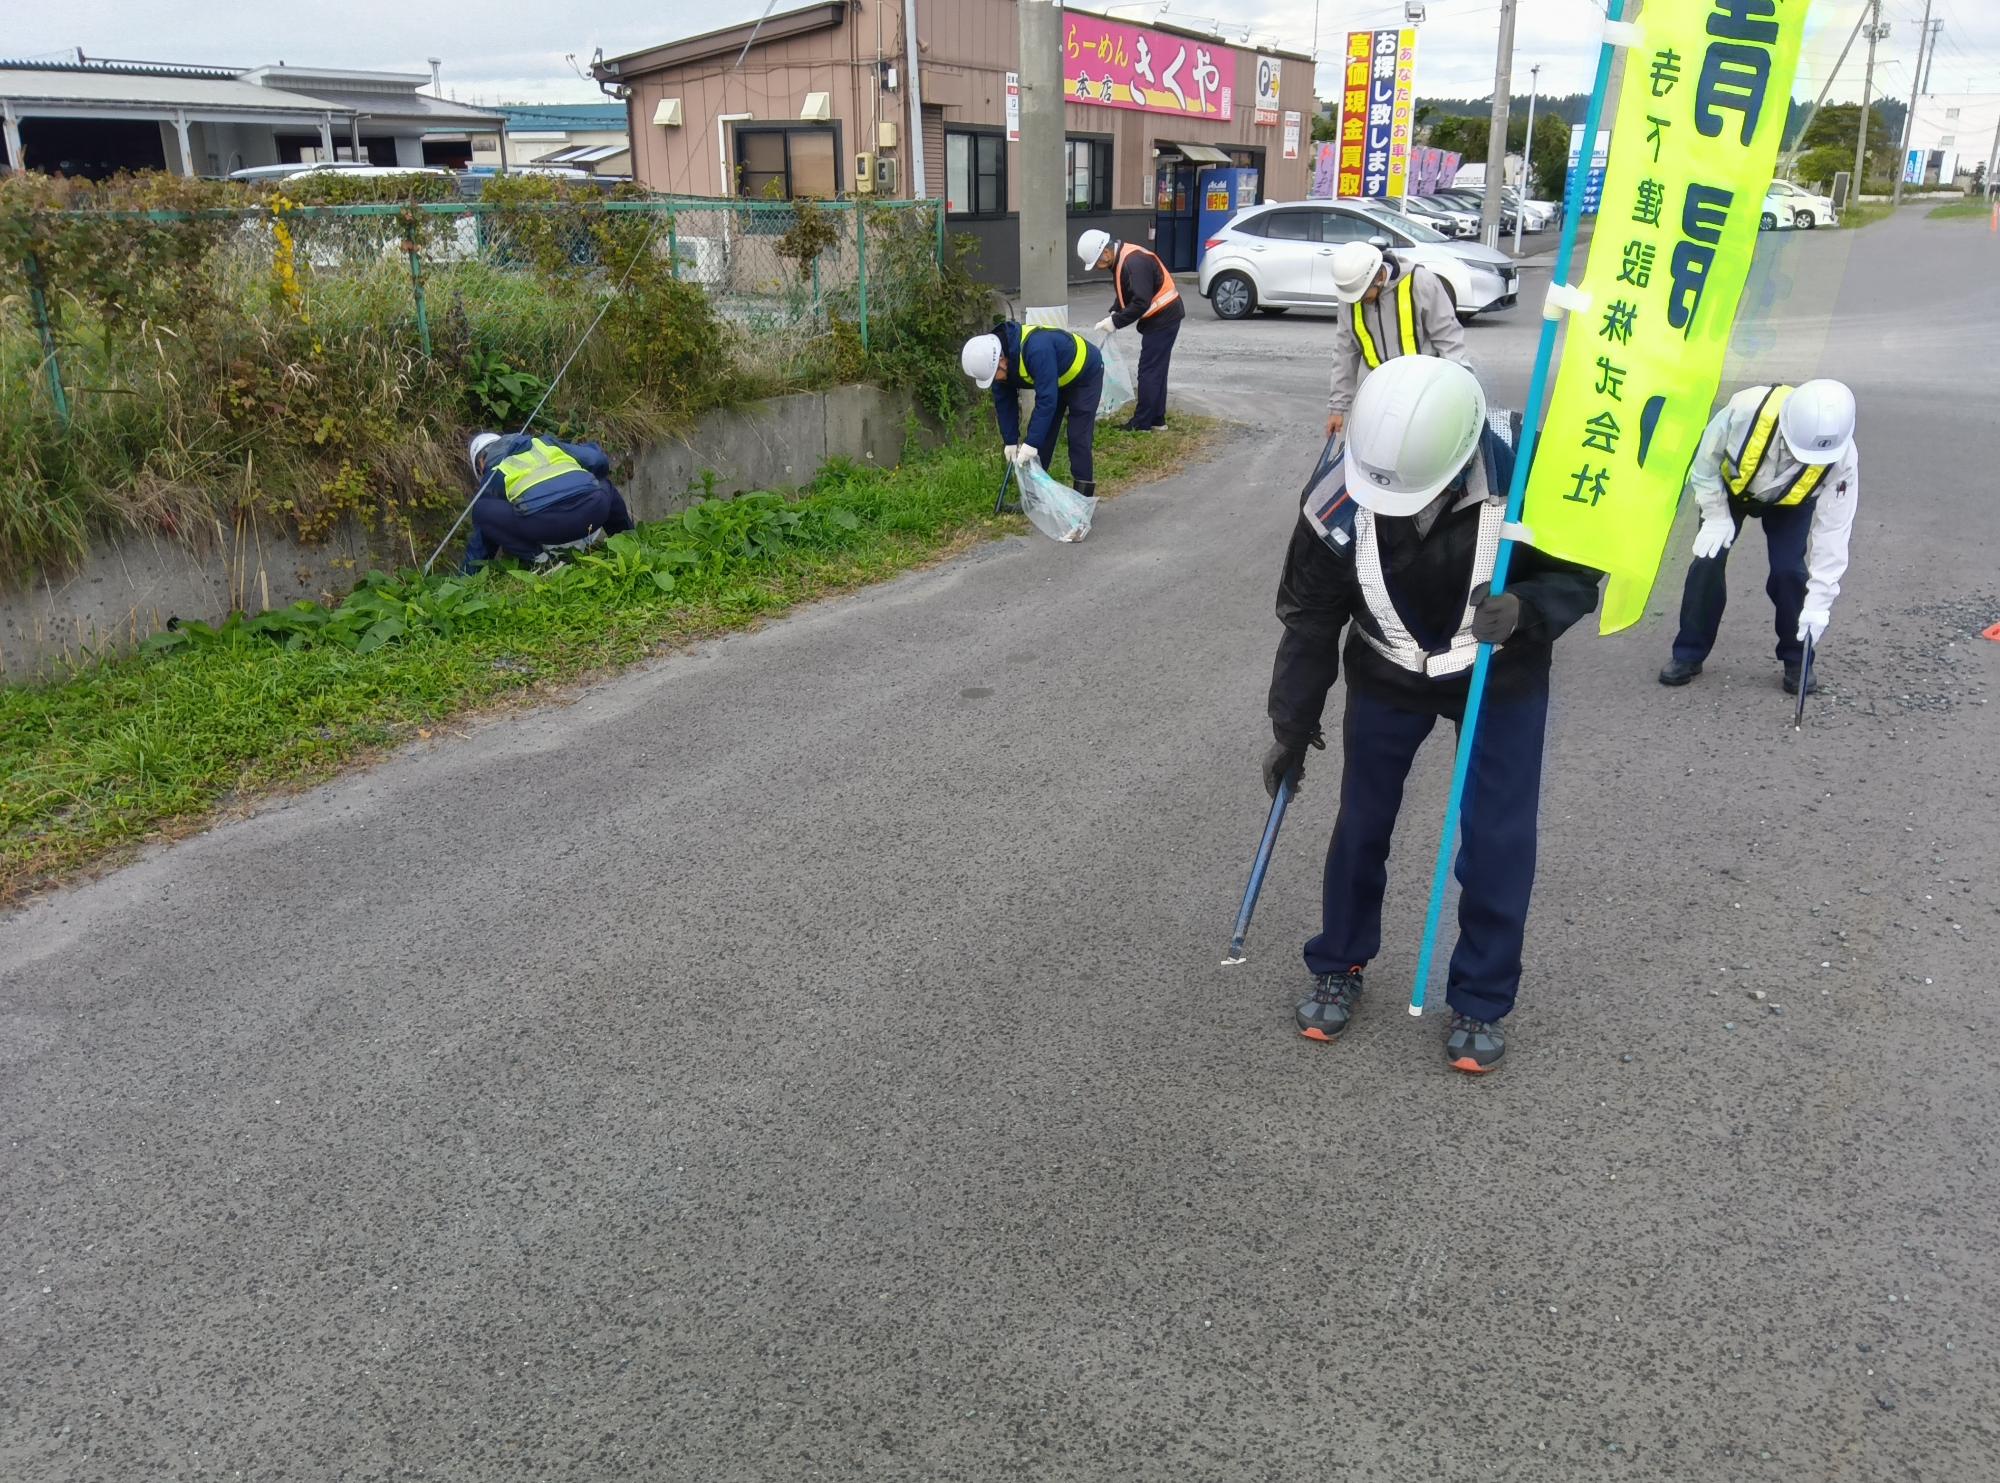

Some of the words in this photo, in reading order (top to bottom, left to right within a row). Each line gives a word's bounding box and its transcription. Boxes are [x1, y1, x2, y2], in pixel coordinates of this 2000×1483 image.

[1067, 23, 1129, 69] らーめん
[1075, 69, 1113, 104] 本店
[1129, 35, 1220, 113] きくや
[1338, 33, 1372, 197] 高価現金買取
[1364, 31, 1398, 197] お探し致します
[1390, 46, 1414, 175] あなたのお車を
